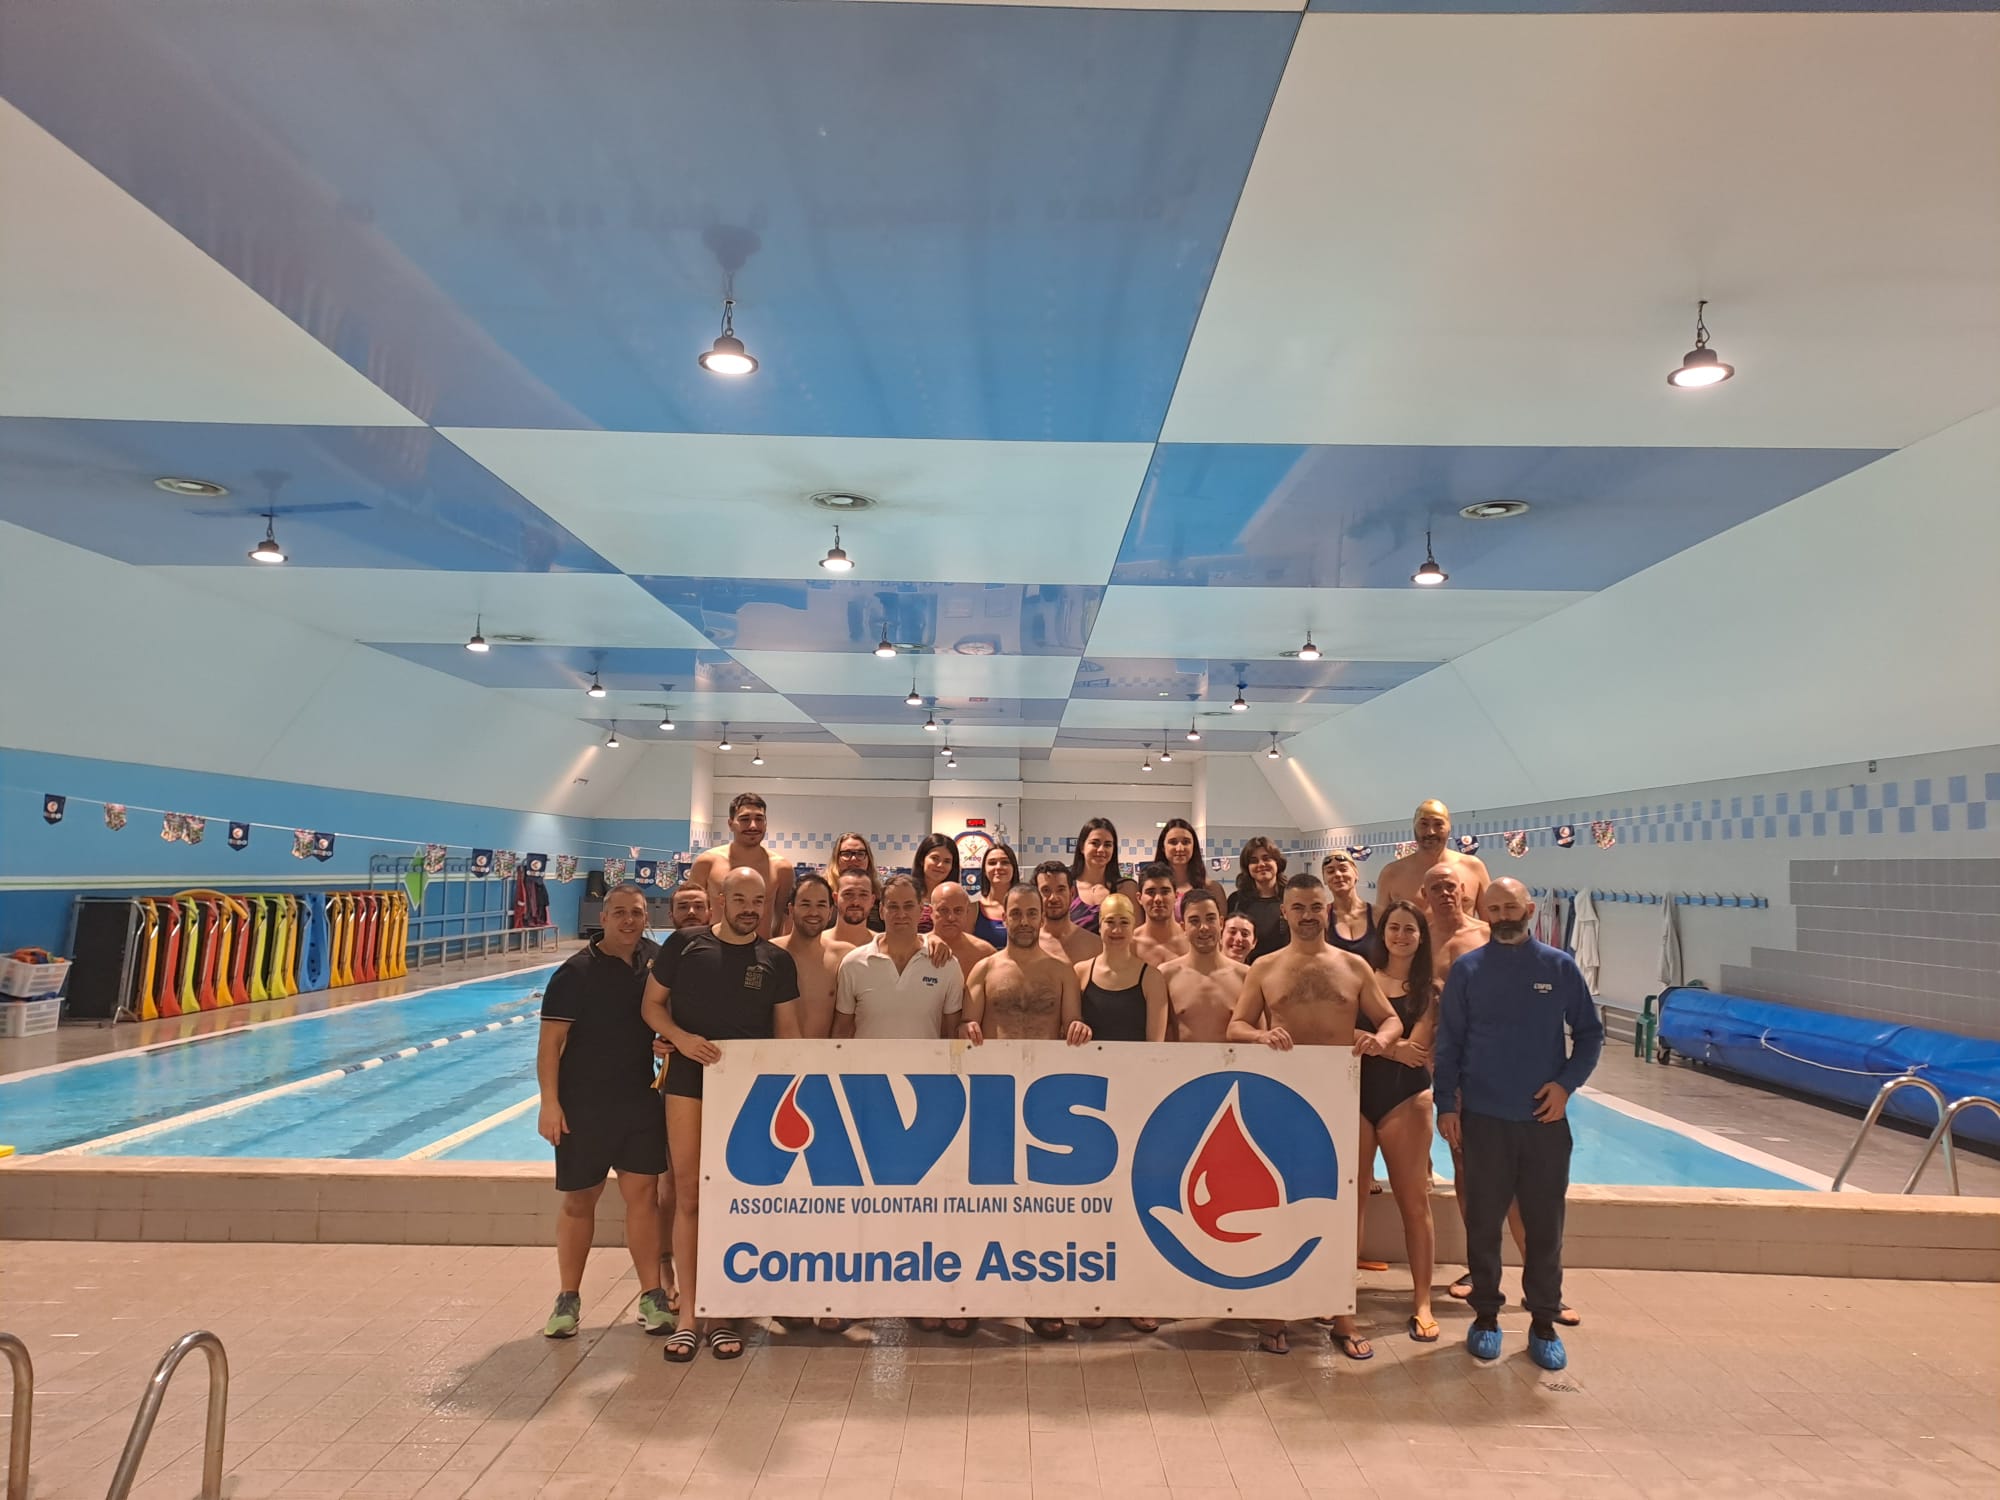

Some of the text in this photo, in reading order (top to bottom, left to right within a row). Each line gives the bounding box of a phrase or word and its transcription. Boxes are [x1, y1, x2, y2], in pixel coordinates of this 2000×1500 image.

[725, 1073, 1119, 1186] AVIS
[729, 1196, 1113, 1214] ASSOCIAZIONE VOLONTARI ITALIANI SANGUE ODV
[723, 1240, 1116, 1283] Comunale Assisi
